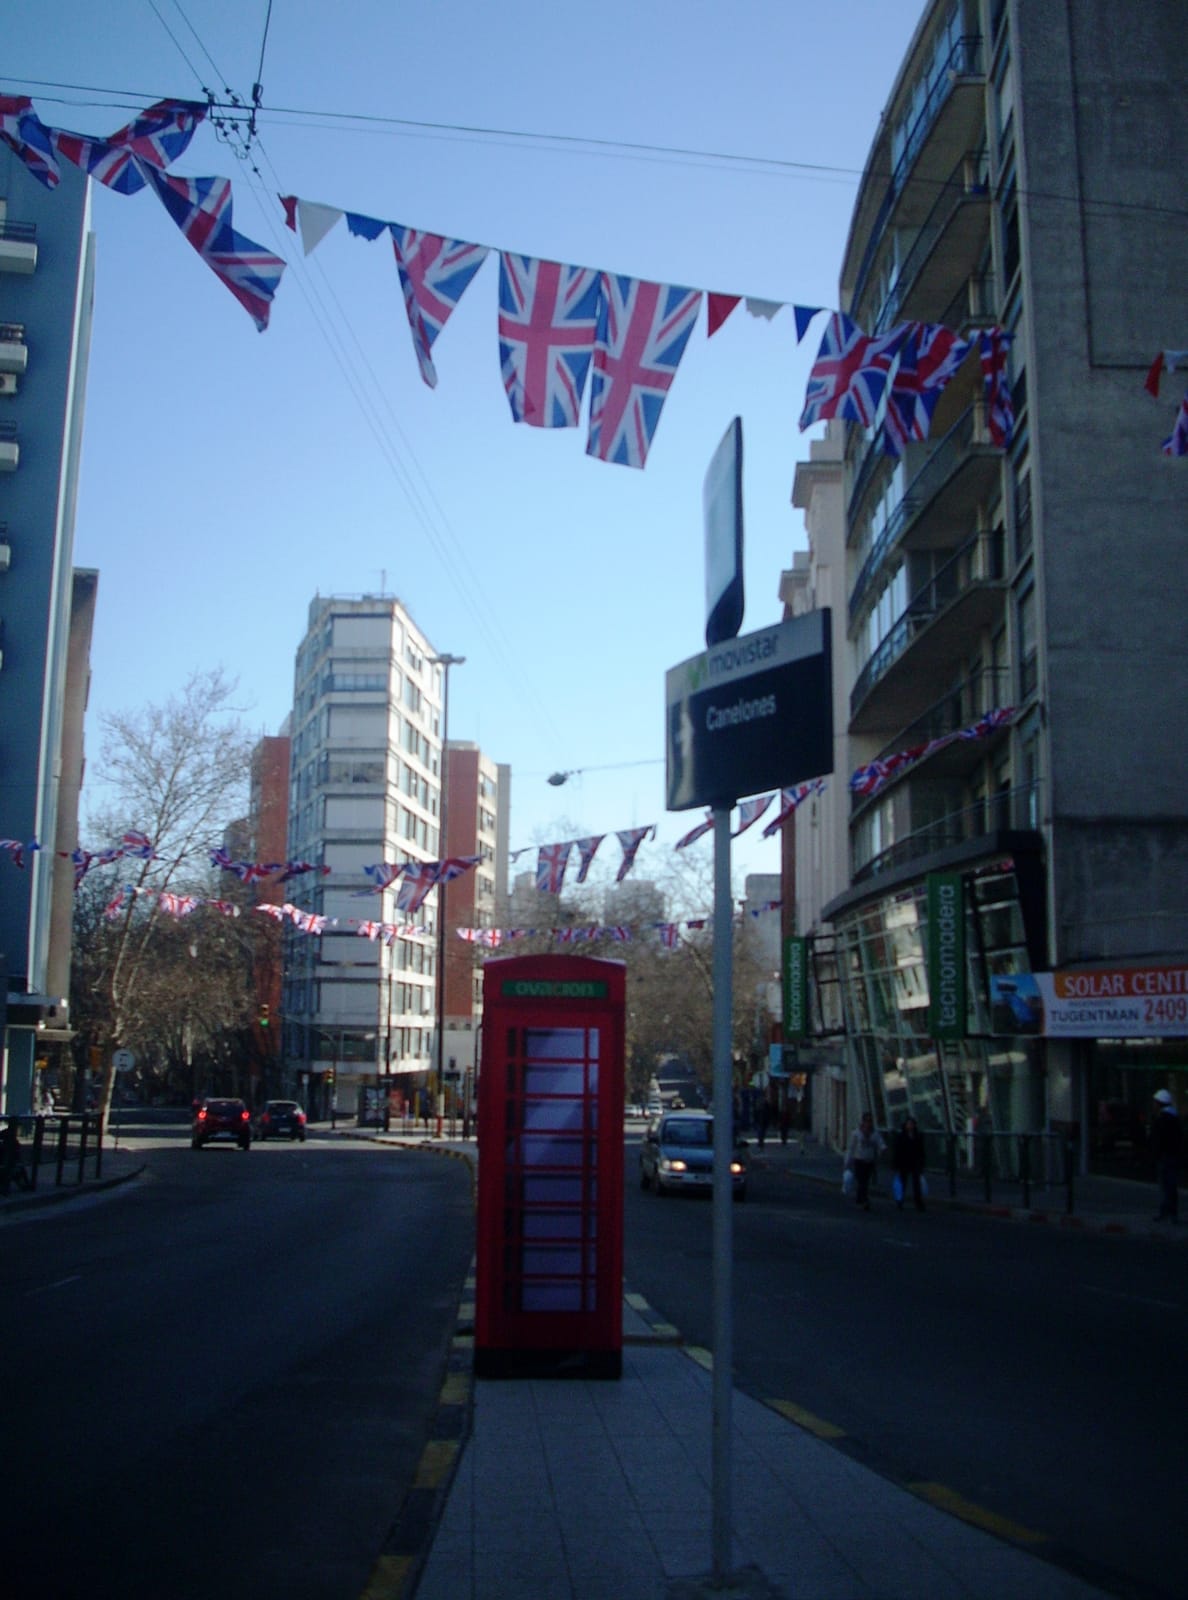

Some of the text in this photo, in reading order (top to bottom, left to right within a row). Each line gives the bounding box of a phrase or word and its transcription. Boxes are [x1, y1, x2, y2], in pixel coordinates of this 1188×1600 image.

[709, 634, 779, 673] movistar
[706, 694, 777, 730] Canelones
[939, 884, 957, 1027] tecnomadera
[789, 943, 801, 1032] tecnomadera
[1064, 970, 1188, 996] SOLAR CENT
[1050, 1009, 1139, 1022] TUGENTMAN
[1143, 998, 1187, 1023] 2409
